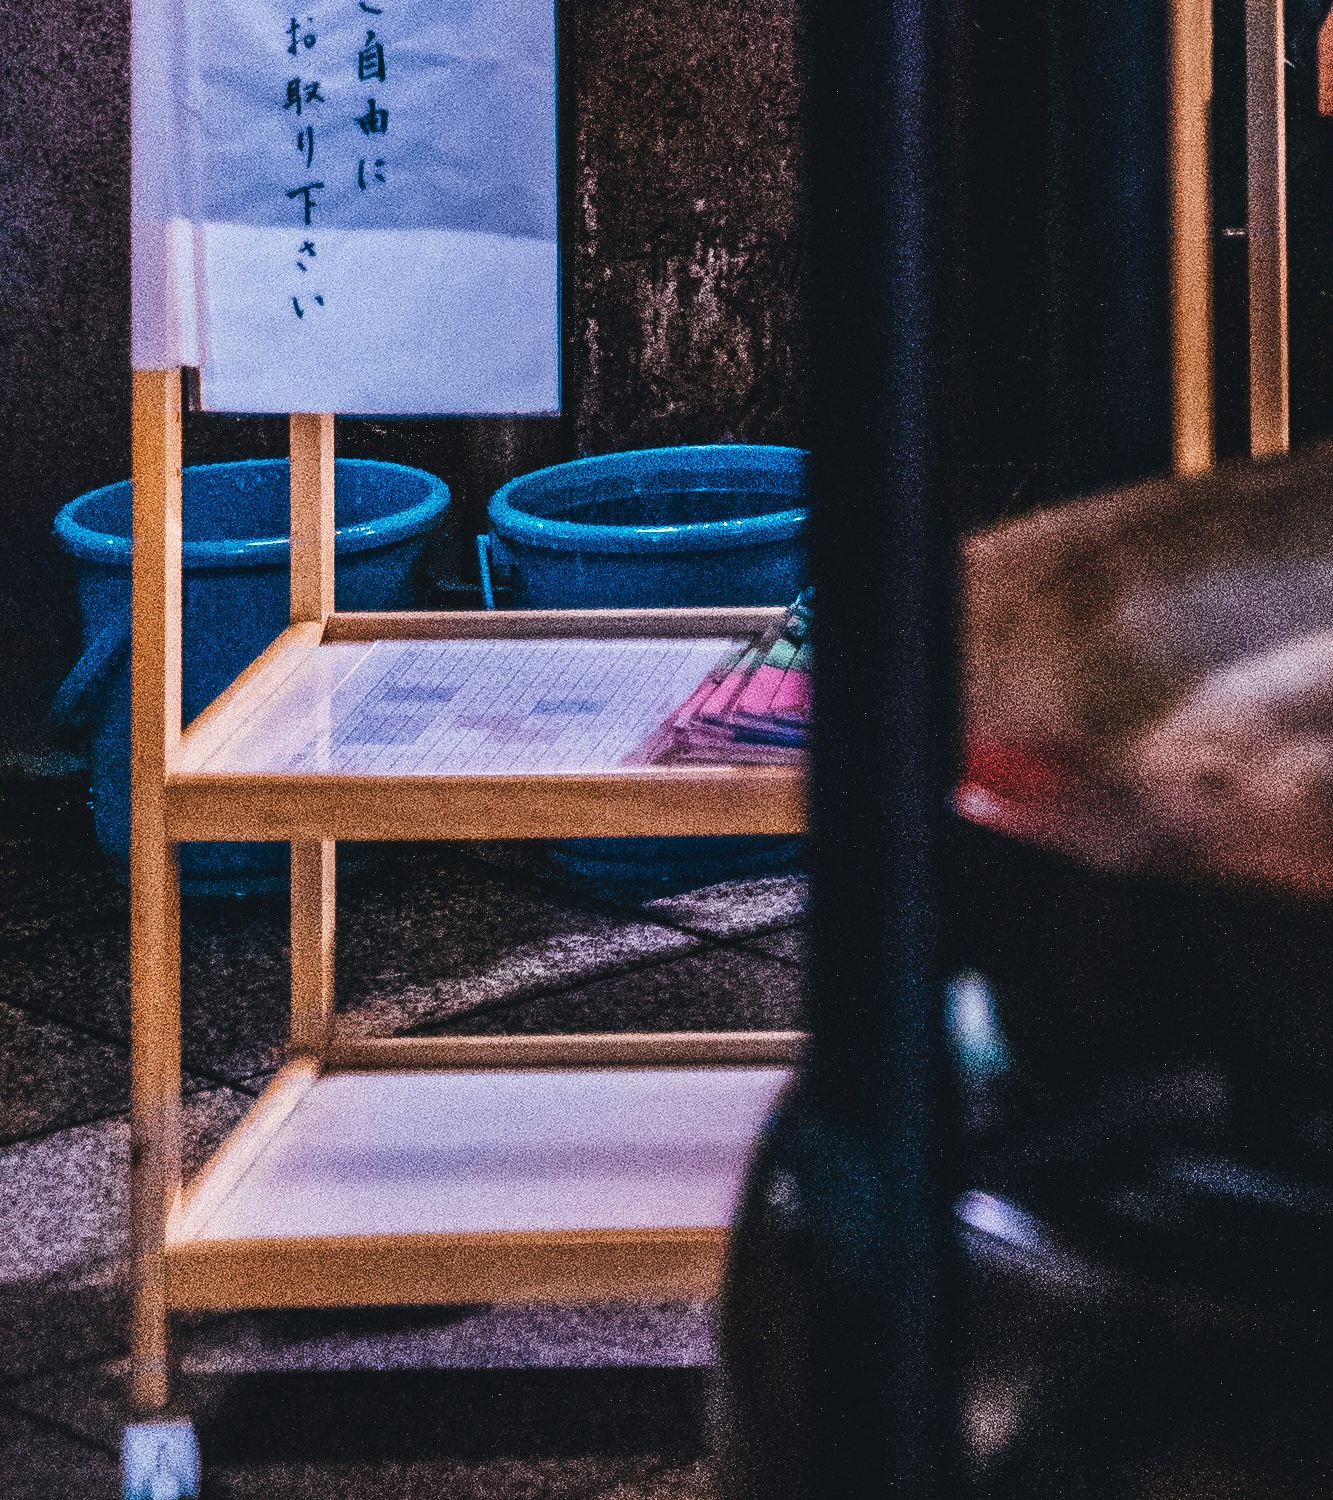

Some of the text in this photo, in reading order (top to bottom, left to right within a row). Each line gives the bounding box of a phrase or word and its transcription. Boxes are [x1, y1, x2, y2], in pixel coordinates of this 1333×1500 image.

[283, 16, 326, 320] お取り下さい
